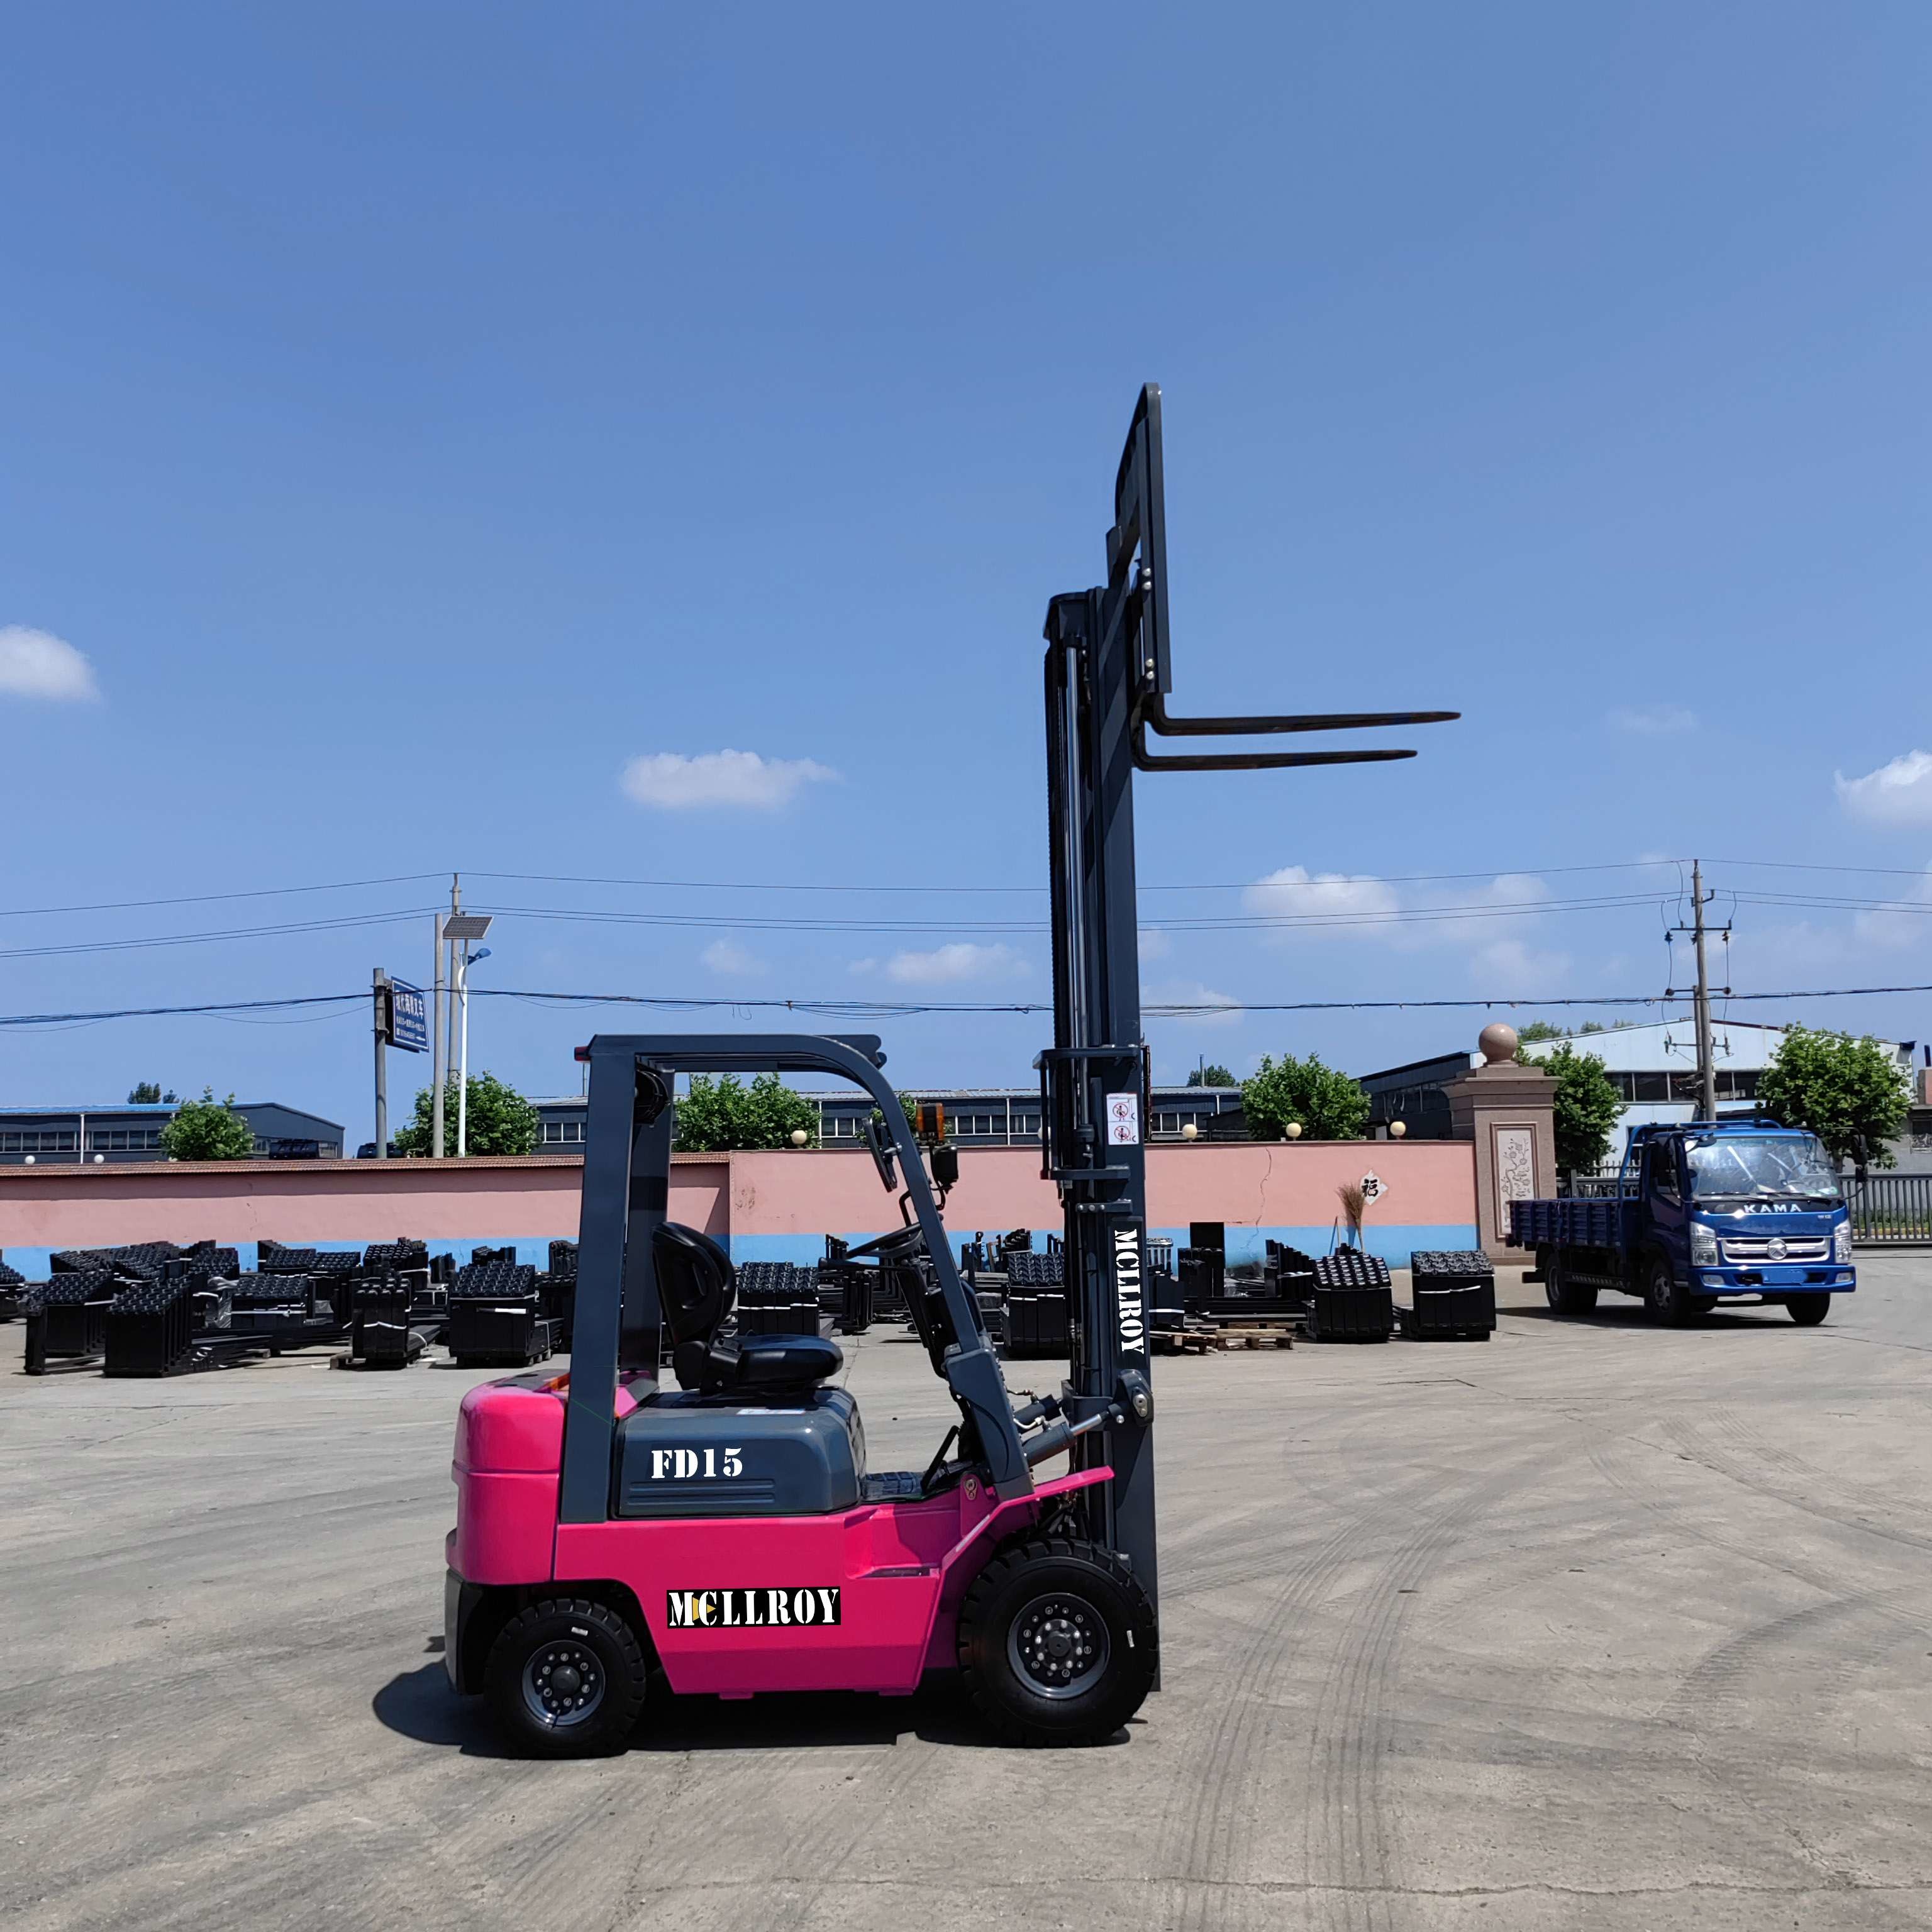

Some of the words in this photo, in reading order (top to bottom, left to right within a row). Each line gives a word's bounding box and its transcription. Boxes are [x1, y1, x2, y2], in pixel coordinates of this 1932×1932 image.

[1362, 1179, 1379, 1197] 福
[1743, 1204, 1802, 1213] KAMA
[1114, 1229, 1145, 1355] MCLLROY
[651, 1448, 743, 1479] FD15
[669, 1589, 839, 1626] MCLLROY
